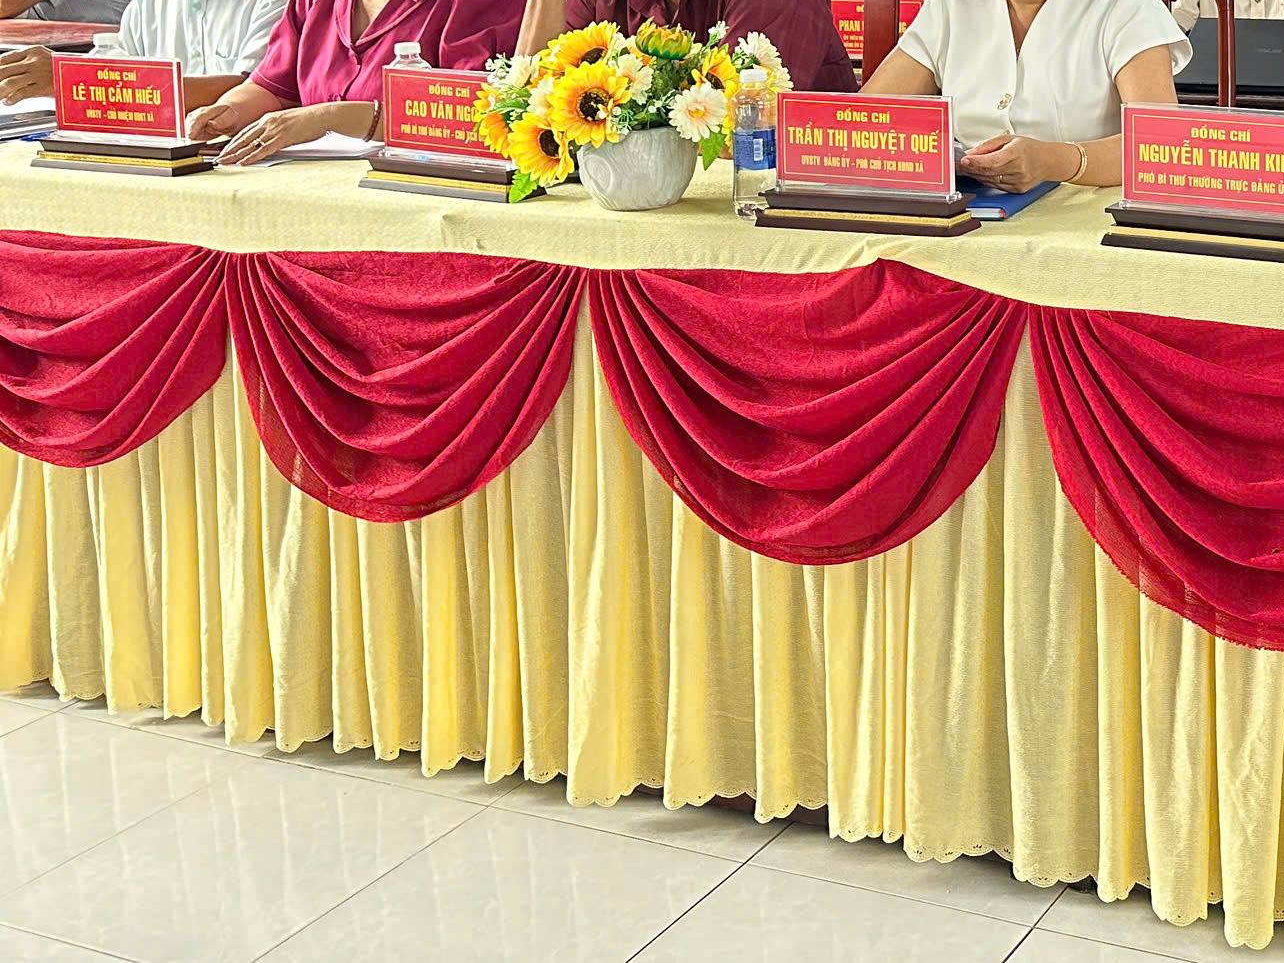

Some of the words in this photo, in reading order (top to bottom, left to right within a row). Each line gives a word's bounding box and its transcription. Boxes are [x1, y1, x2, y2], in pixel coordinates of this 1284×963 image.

[838, 19, 860, 32] PHAN
[97, 67, 120, 80] ĐỒNG
[122, 69, 137, 82] CHÍ
[72, 83, 86, 101] LÊ
[88, 86, 106, 105] THỊ
[108, 81, 133, 104] CẨM
[135, 85, 161, 105] HIẾU
[428, 83, 453, 97] ĐỒNG
[455, 87, 470, 97] CHÍ
[405, 99, 427, 117] CAO
[430, 100, 453, 120] VĂN
[456, 104, 480, 123] NGO
[836, 107, 868, 122] ĐỒNG
[871, 110, 891, 124] CHÍ
[787, 121, 823, 146] TRẦN
[827, 127, 848, 151] THỊ
[851, 129, 906, 154] NGUYỆT
[911, 130, 939, 154] QUẾ
[1190, 124, 1226, 141] ĐỒNG
[1229, 129, 1250, 142] CHÍ
[1138, 139, 1203, 167] NGUYỄN
[1208, 149, 1260, 171] THANH
[1137, 171, 1155, 184] PHÓ
[1158, 172, 1167, 185] BÍ
[1169, 174, 1186, 186] THƯ
[1188, 174, 1223, 190] THƯỜNG
[1225, 178, 1249, 194] TRỰC
[1251, 178, 1276, 194] ĐẢNG
